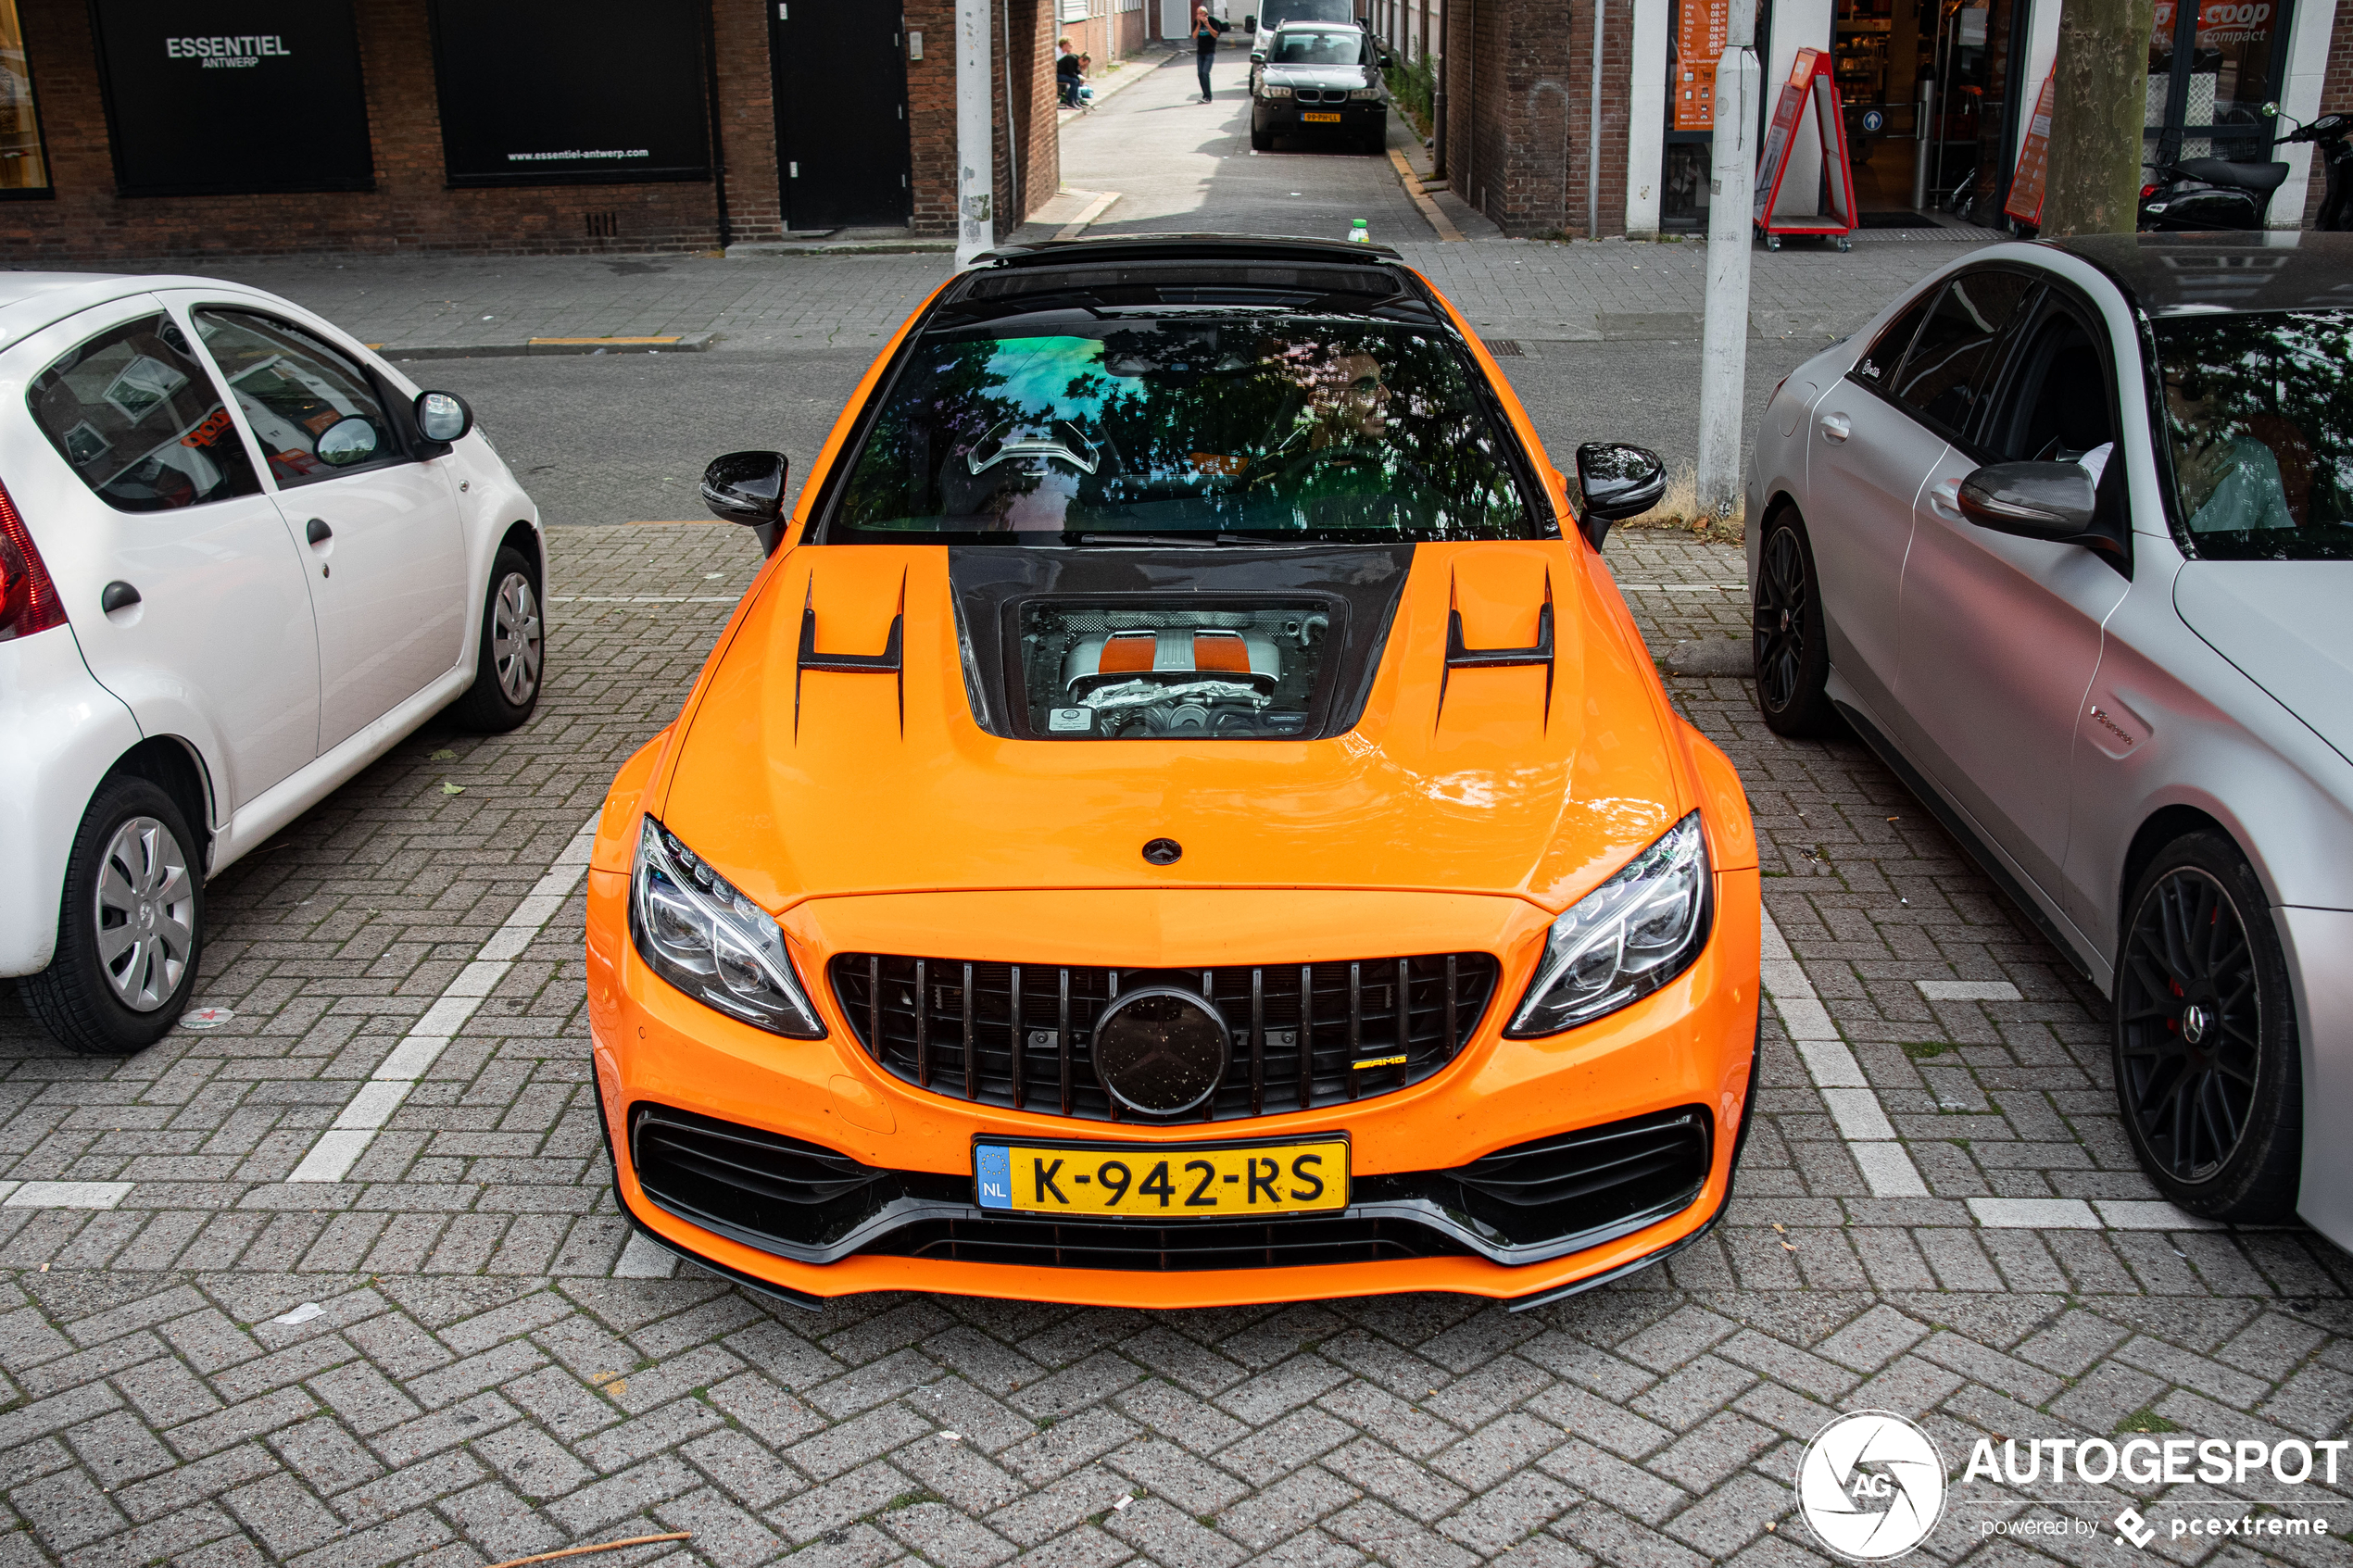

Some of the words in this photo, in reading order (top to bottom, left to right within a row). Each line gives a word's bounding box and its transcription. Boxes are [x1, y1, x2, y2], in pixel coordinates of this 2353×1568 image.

[2205, 3, 2270, 29] coop
[2203, 29, 2267, 45] compact
[166, 35, 291, 57] ESSENTIEL
[202, 56, 259, 69] ANTWERP
[508, 149, 649, 161] www.essentiel-antwerp.com
[1370, 1055, 1407, 1067] AMG
[982, 1182, 1007, 1198] NL
[1034, 1154, 1325, 1207] K-942-RS
